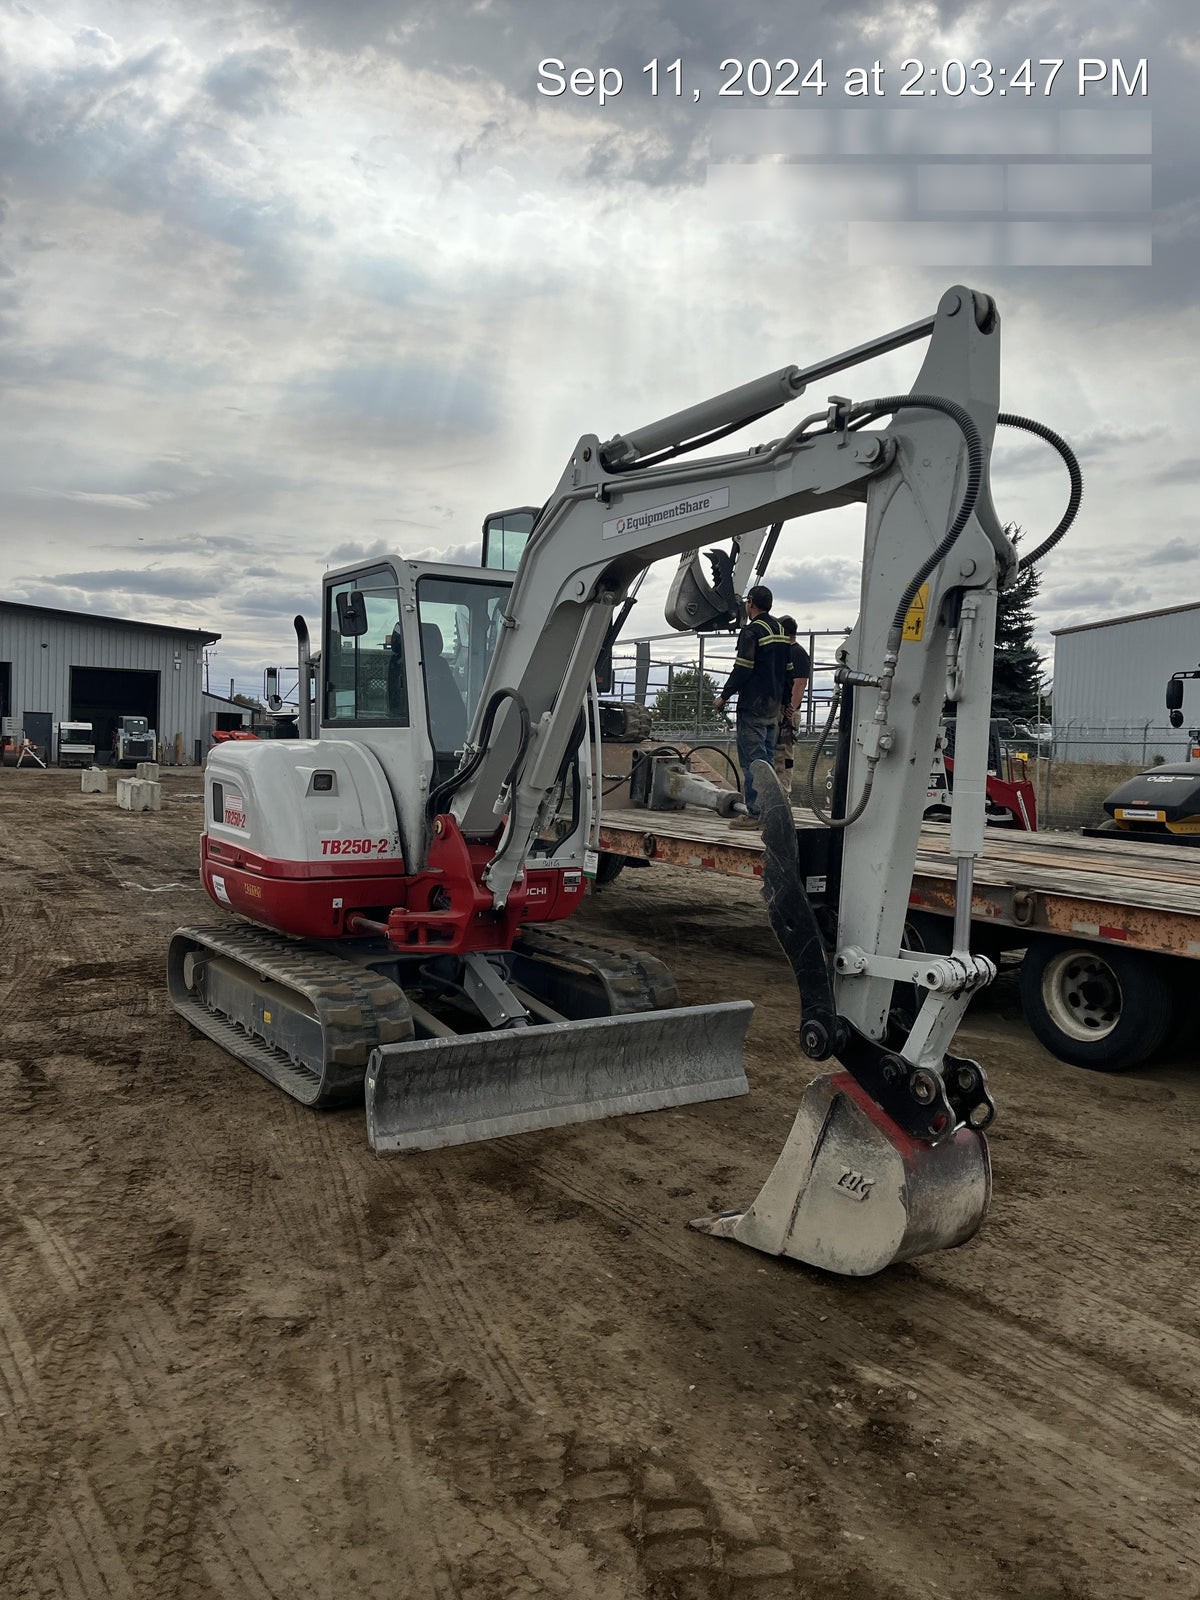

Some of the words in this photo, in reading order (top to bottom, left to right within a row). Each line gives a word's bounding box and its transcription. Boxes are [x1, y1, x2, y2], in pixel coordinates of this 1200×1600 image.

[626, 498, 710, 530] EquipmentShare
[225, 809, 246, 828] TB250-2
[321, 838, 388, 855] TB250-2
